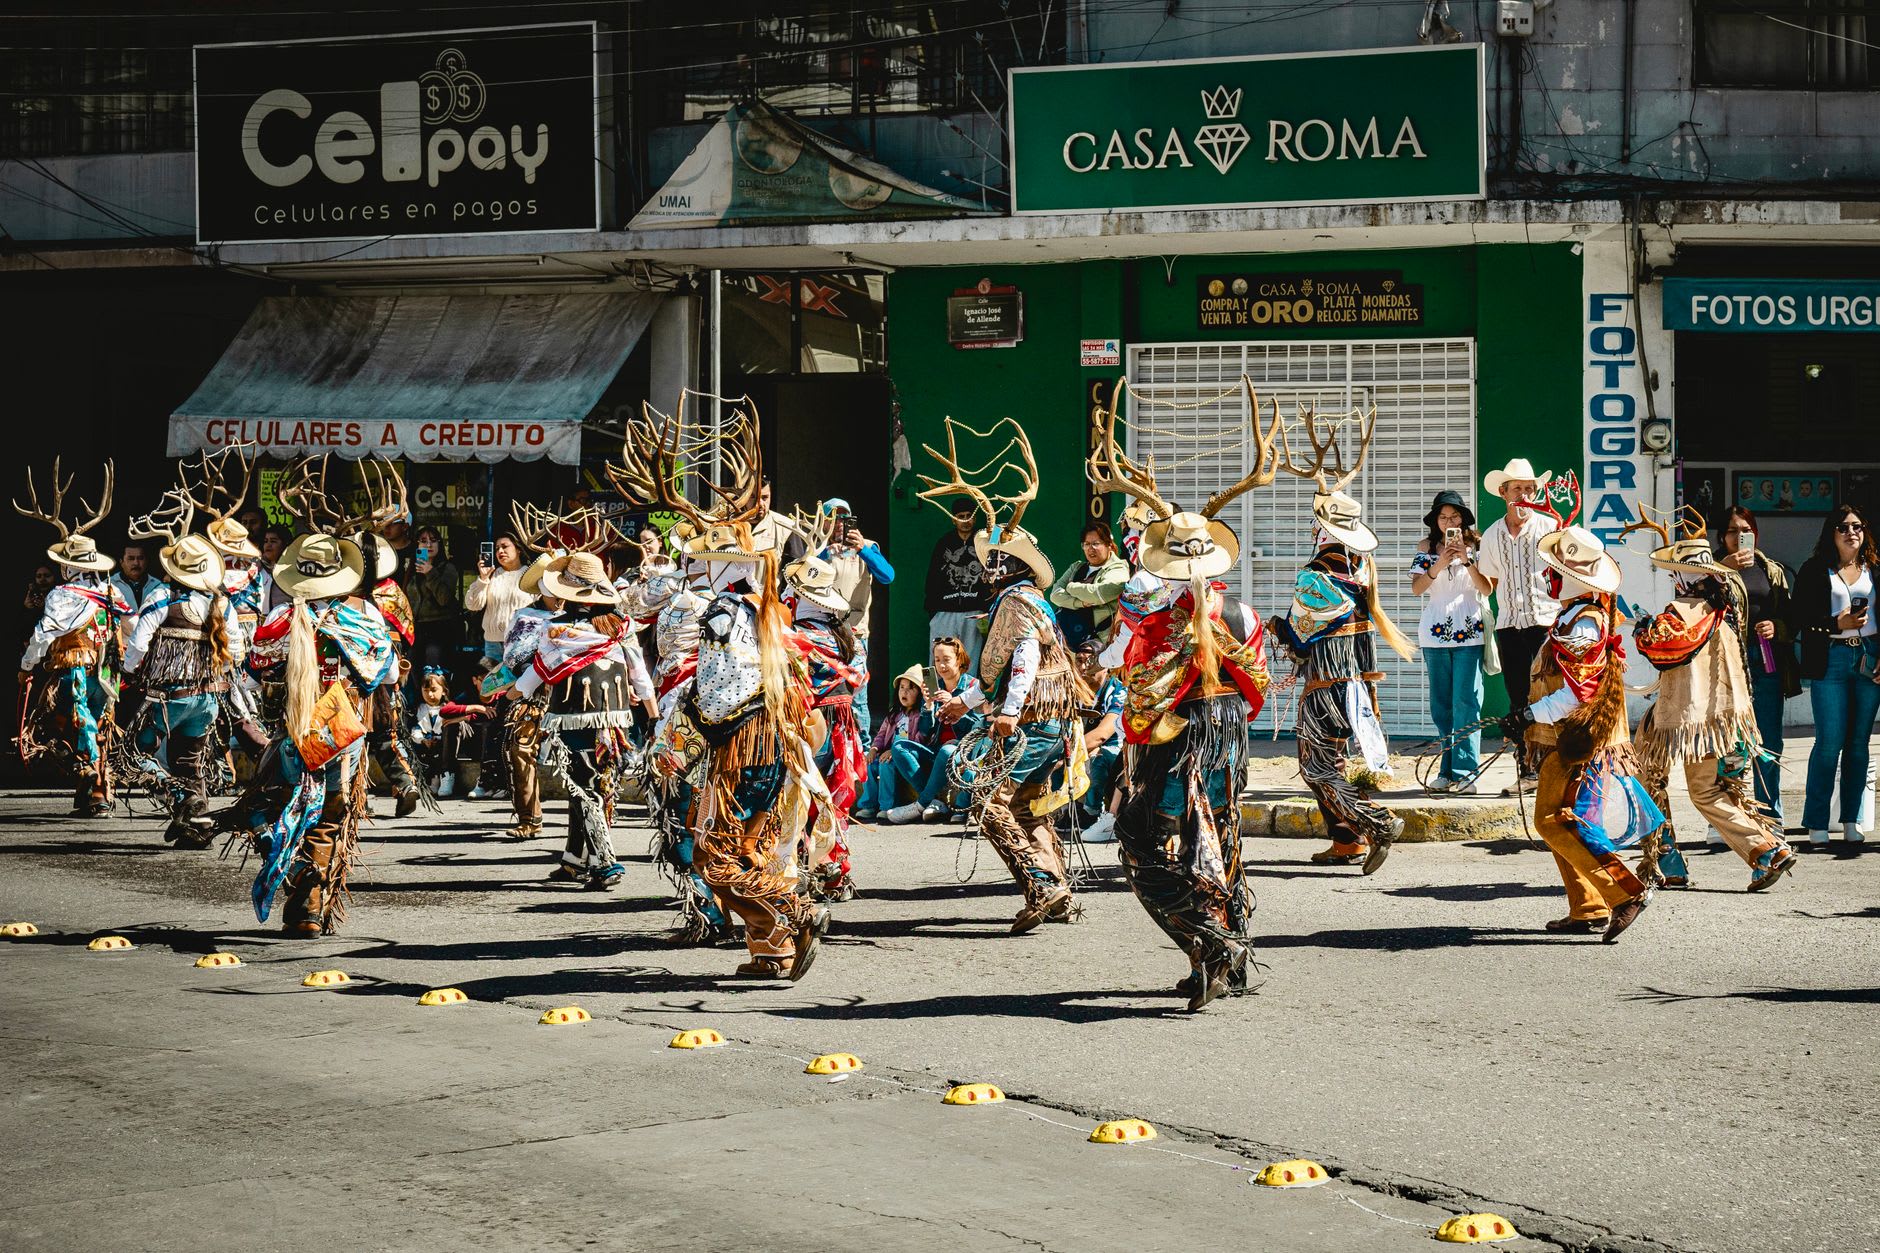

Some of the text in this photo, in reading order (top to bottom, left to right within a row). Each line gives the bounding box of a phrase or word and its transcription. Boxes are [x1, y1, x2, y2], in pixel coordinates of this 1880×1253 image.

[1063, 116, 1427, 174] CASA ROMA
[659, 195, 692, 209] UMAI
[254, 197, 539, 226] Celulares en pagos
[1259, 282, 1362, 297] CASA ROMA
[1201, 298, 1249, 312] COMPRA Y
[1323, 294, 1411, 308] PLATA MONEDAS
[964, 306, 1002, 316] Ignacio José
[1251, 299, 1314, 324] ORO
[1317, 307, 1419, 323] RELOJES DIAMANTES
[1691, 295, 1797, 326] FOTOS
[976, 315, 1001, 323] Allende
[1201, 312, 1248, 325] VENTA DE
[206, 418, 545, 448] CELULARES A CRÉDITO
[414, 484, 484, 510] Celpay
